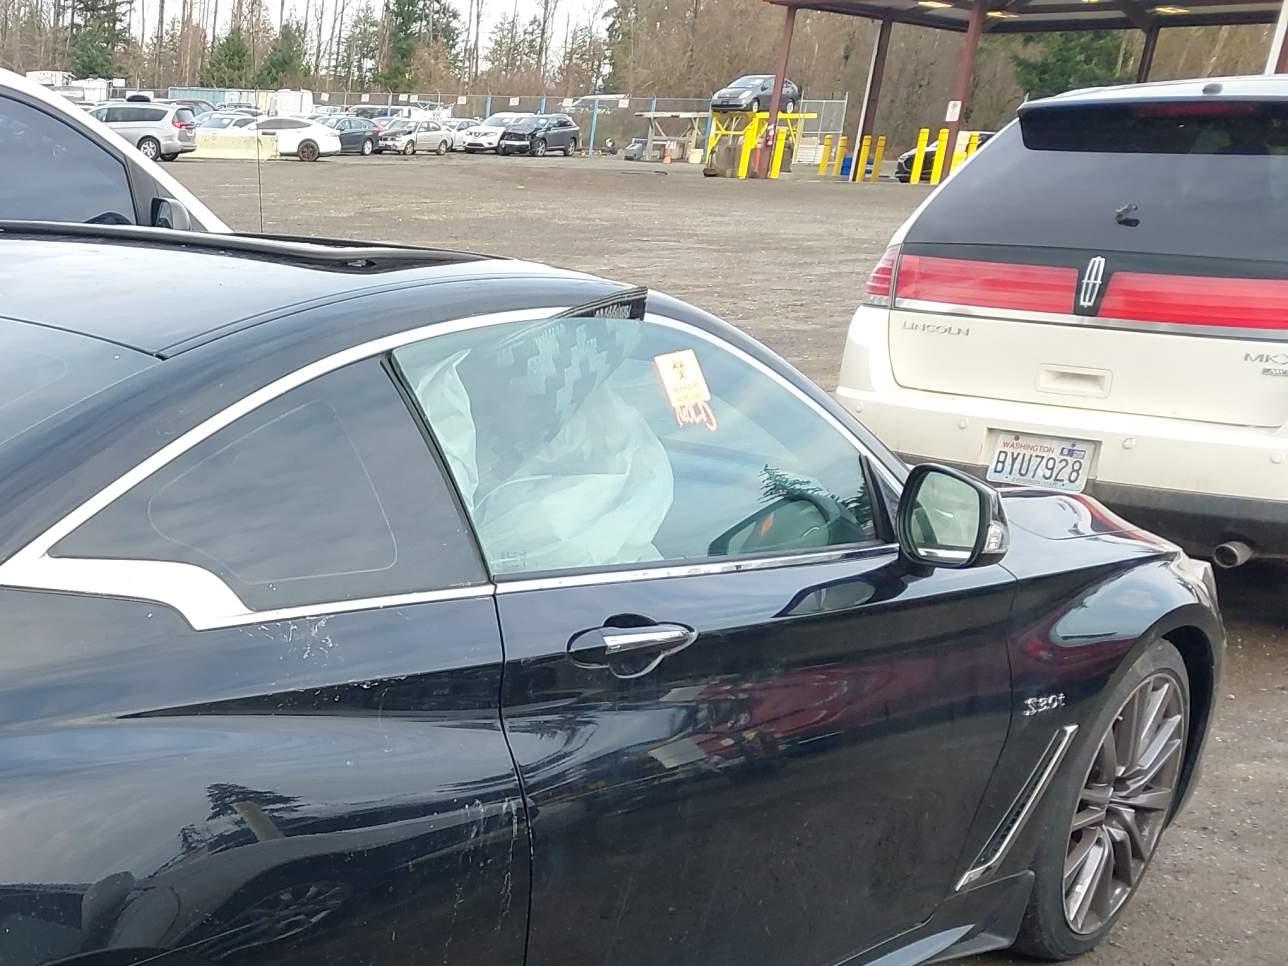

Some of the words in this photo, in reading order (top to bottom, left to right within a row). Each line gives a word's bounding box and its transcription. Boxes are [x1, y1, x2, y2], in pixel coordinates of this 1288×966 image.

[903, 320, 970, 337] LINCOLN
[1002, 441, 1055, 454] WASHINGTON
[993, 450, 1083, 484] BYU7928
